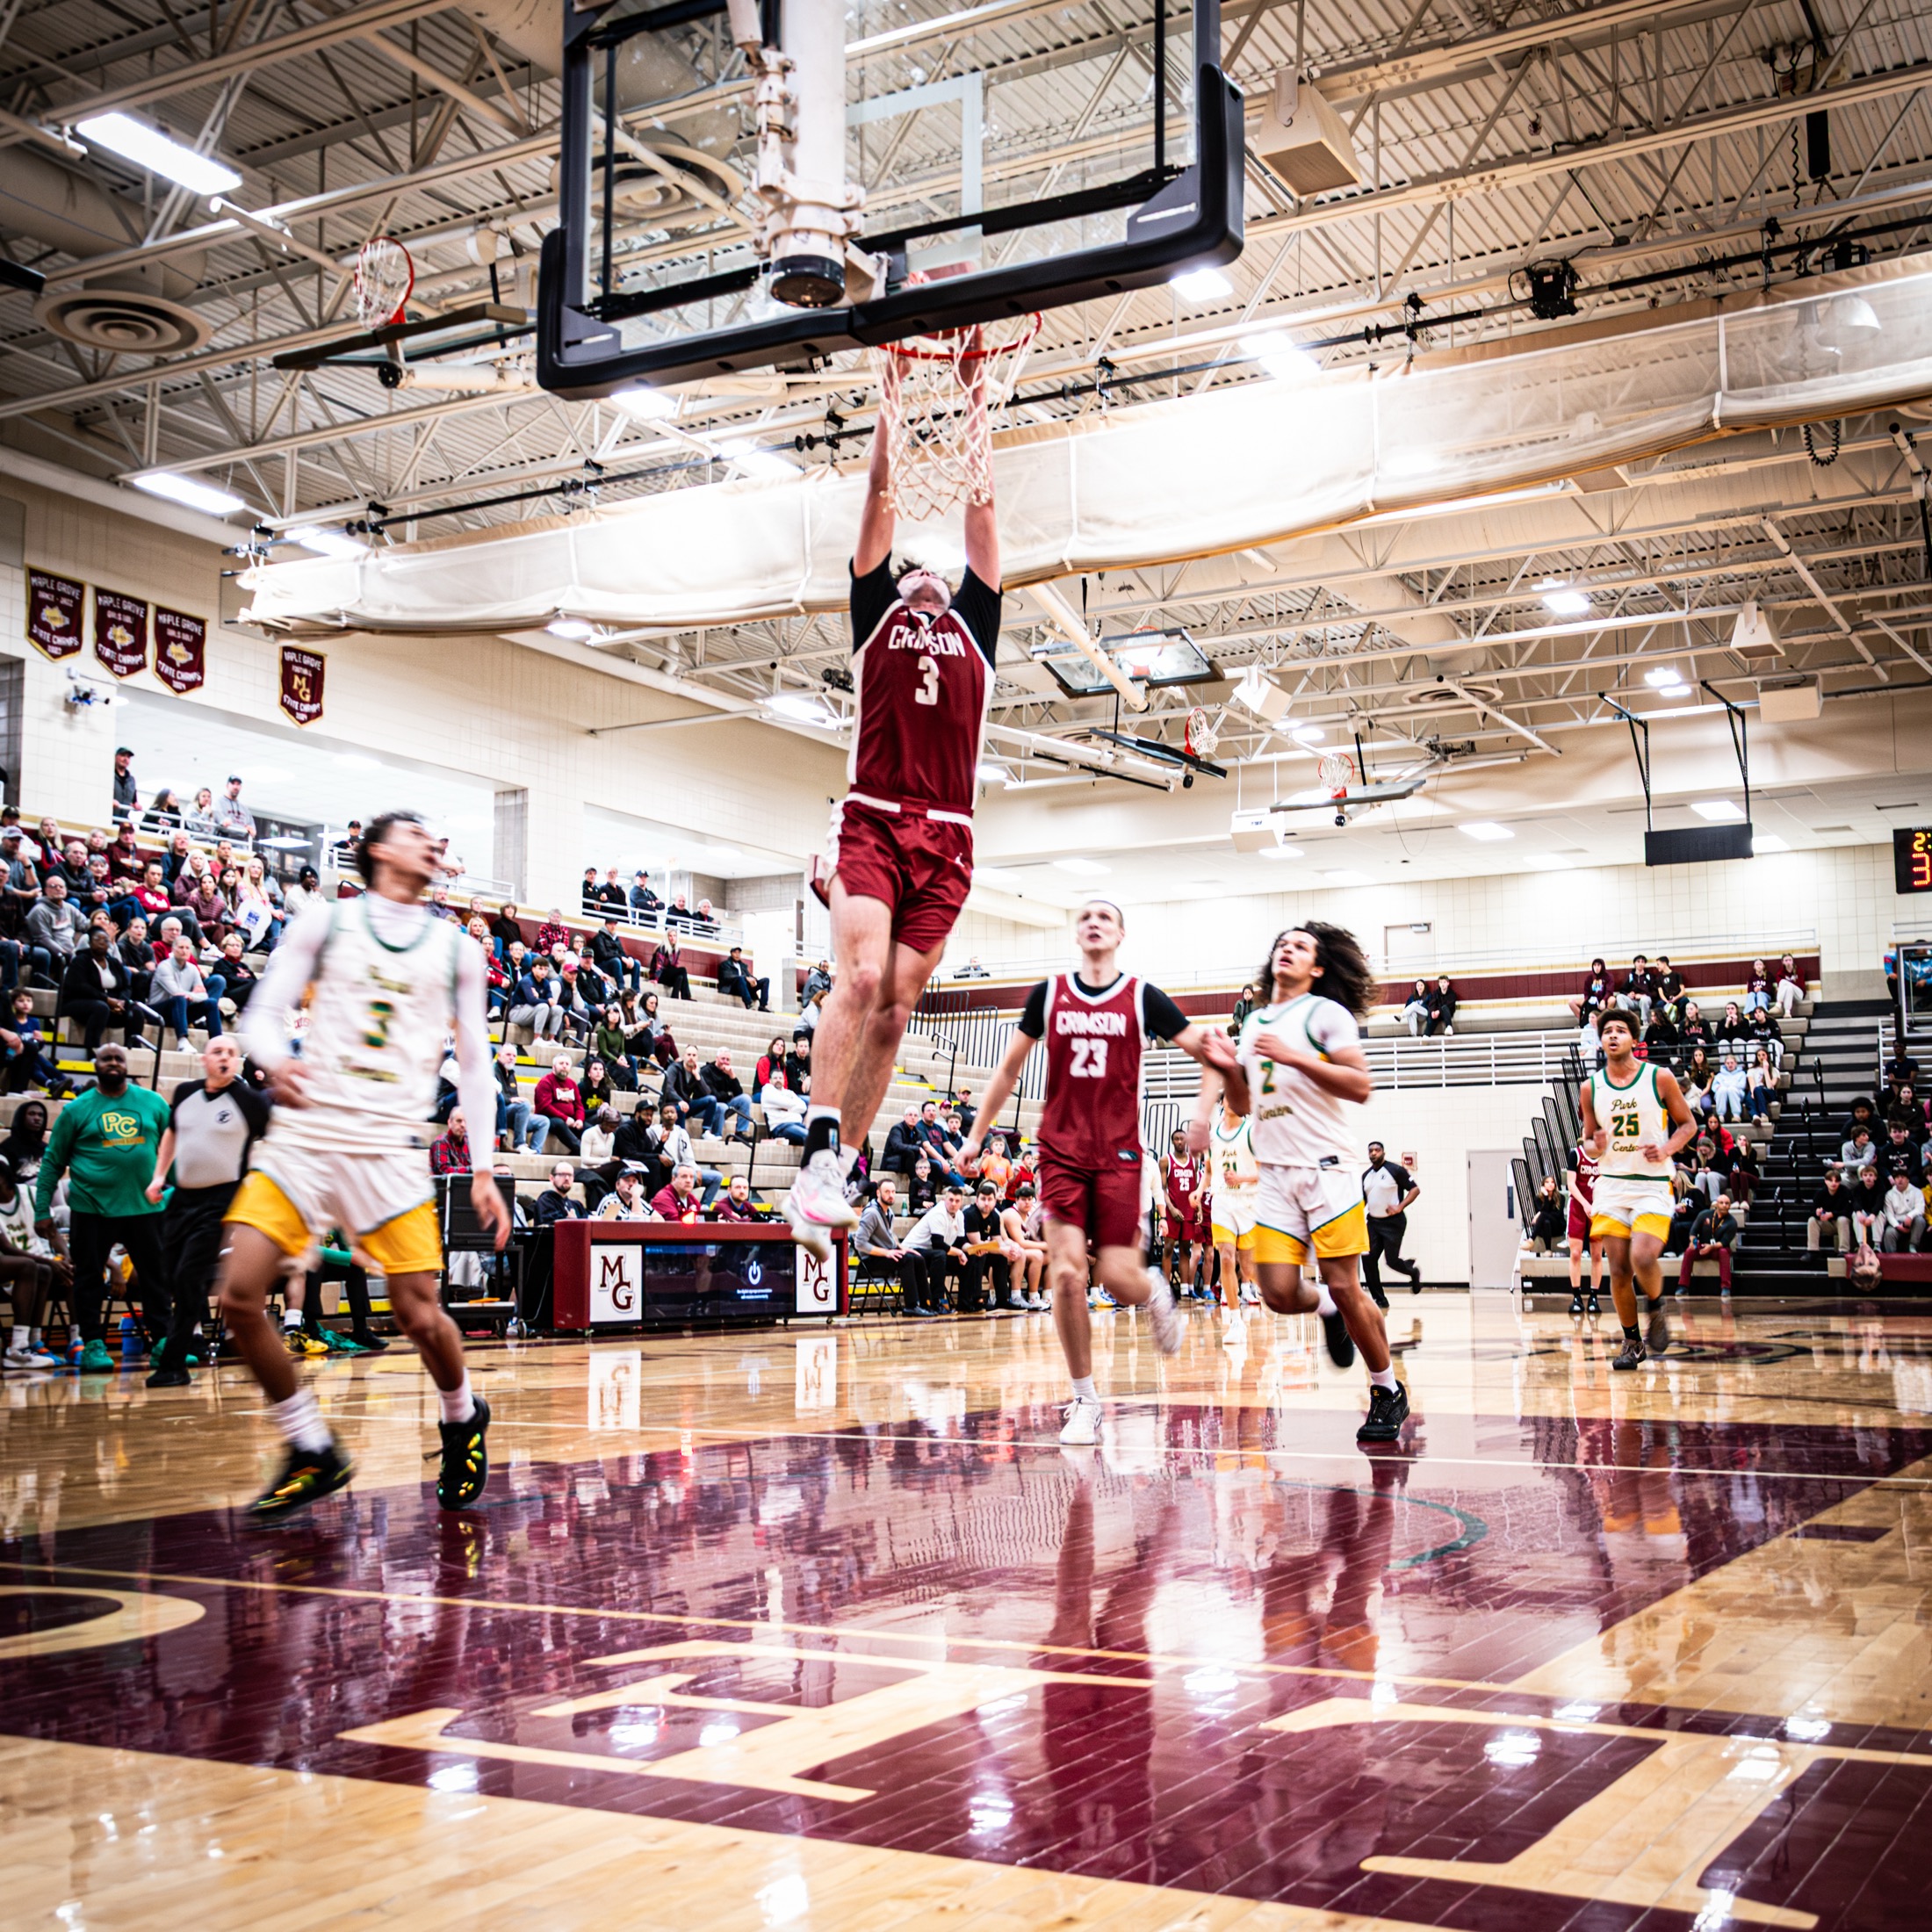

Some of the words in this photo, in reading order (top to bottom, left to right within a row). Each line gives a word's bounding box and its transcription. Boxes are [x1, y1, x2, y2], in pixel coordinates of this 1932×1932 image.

[31, 576, 55, 590] MAPLE
[56, 580, 82, 600] GROVE
[97, 595, 121, 609] MAPLE
[121, 600, 146, 618] GROVE
[32, 624, 52, 643] STATE
[52, 634, 79, 646] CHAMPS
[157, 613, 181, 628] MAPLE
[181, 618, 204, 637] GROVE
[888, 624, 966, 658] CRIMSON
[97, 644, 116, 660] STATE
[118, 654, 144, 665] CHAMPS
[284, 651, 302, 663] MAPLE
[302, 655, 322, 671] GROVE
[157, 660, 176, 677] STATE
[176, 670, 203, 681] CHAMPS
[915, 656, 940, 706] 3
[292, 674, 311, 703] MG
[284, 694, 299, 710] STATE
[299, 703, 321, 713] CHAMPS
[1056, 1011, 1127, 1037] CRIMSON
[1070, 1038, 1108, 1078] 23
[1259, 1060, 1276, 1095] 2
[1611, 1098, 1637, 1112] Park
[102, 1112, 139, 1137] PC
[1611, 1112, 1640, 1136] 25
[1173, 1169, 1193, 1178] CRIMSON
[1179, 1178, 1189, 1191] 25
[600, 1254, 632, 1310] MG
[804, 1254, 829, 1302] MG
